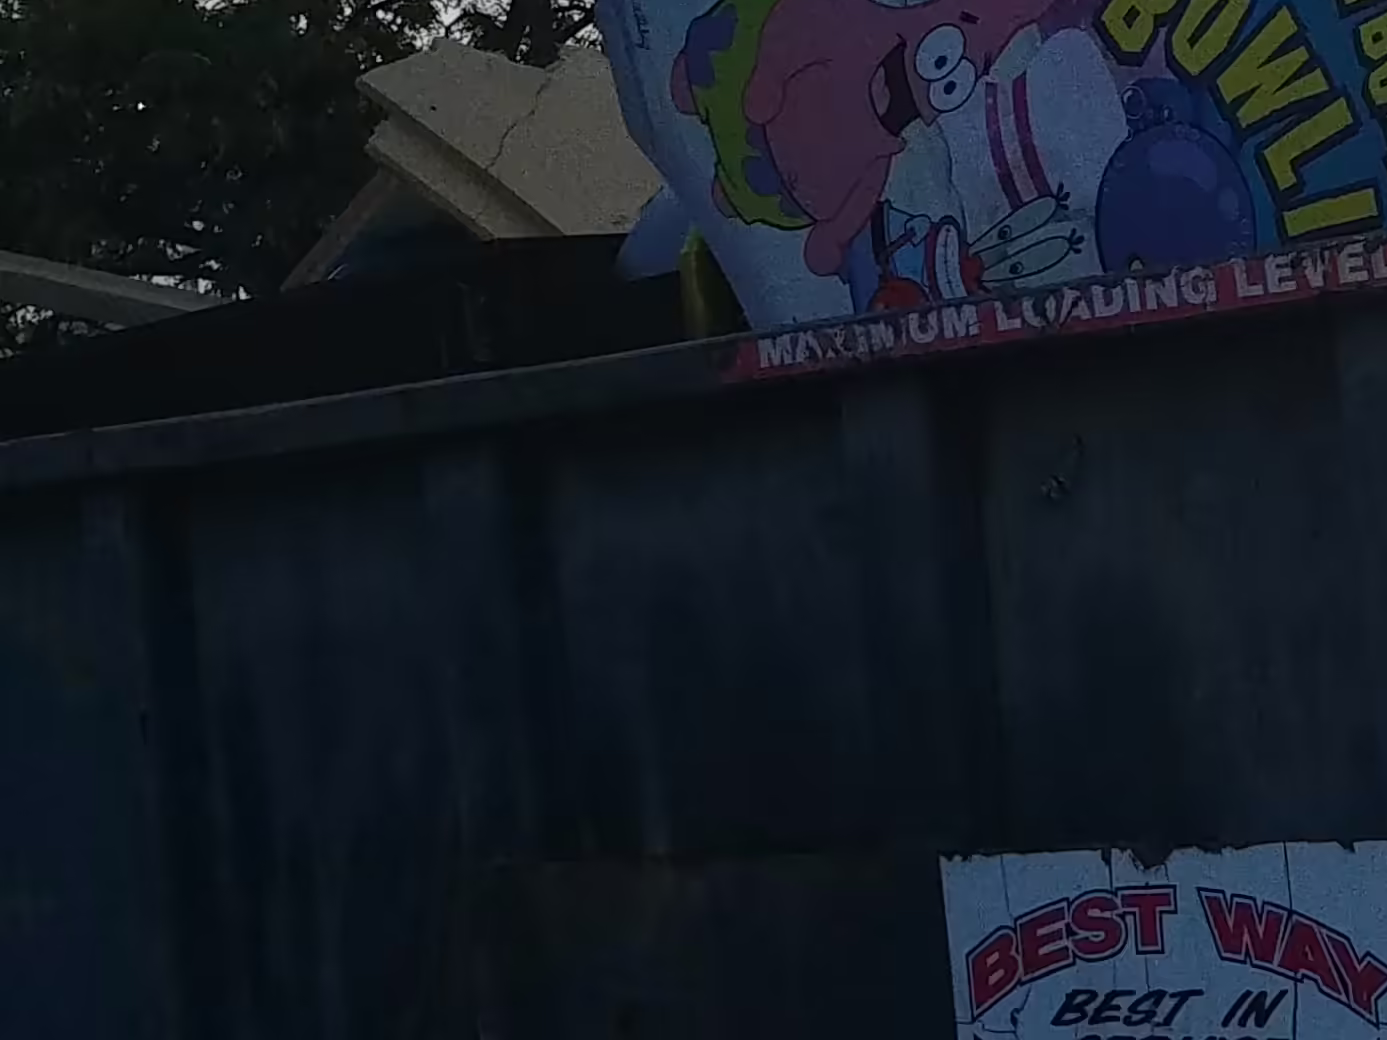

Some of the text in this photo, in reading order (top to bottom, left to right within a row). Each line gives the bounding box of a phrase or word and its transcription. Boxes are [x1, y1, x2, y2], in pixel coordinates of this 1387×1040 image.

[993, 264, 1218, 331] LOADING
[966, 884, 1177, 1021] BEST
[1050, 989, 1288, 1028] BEST IN
